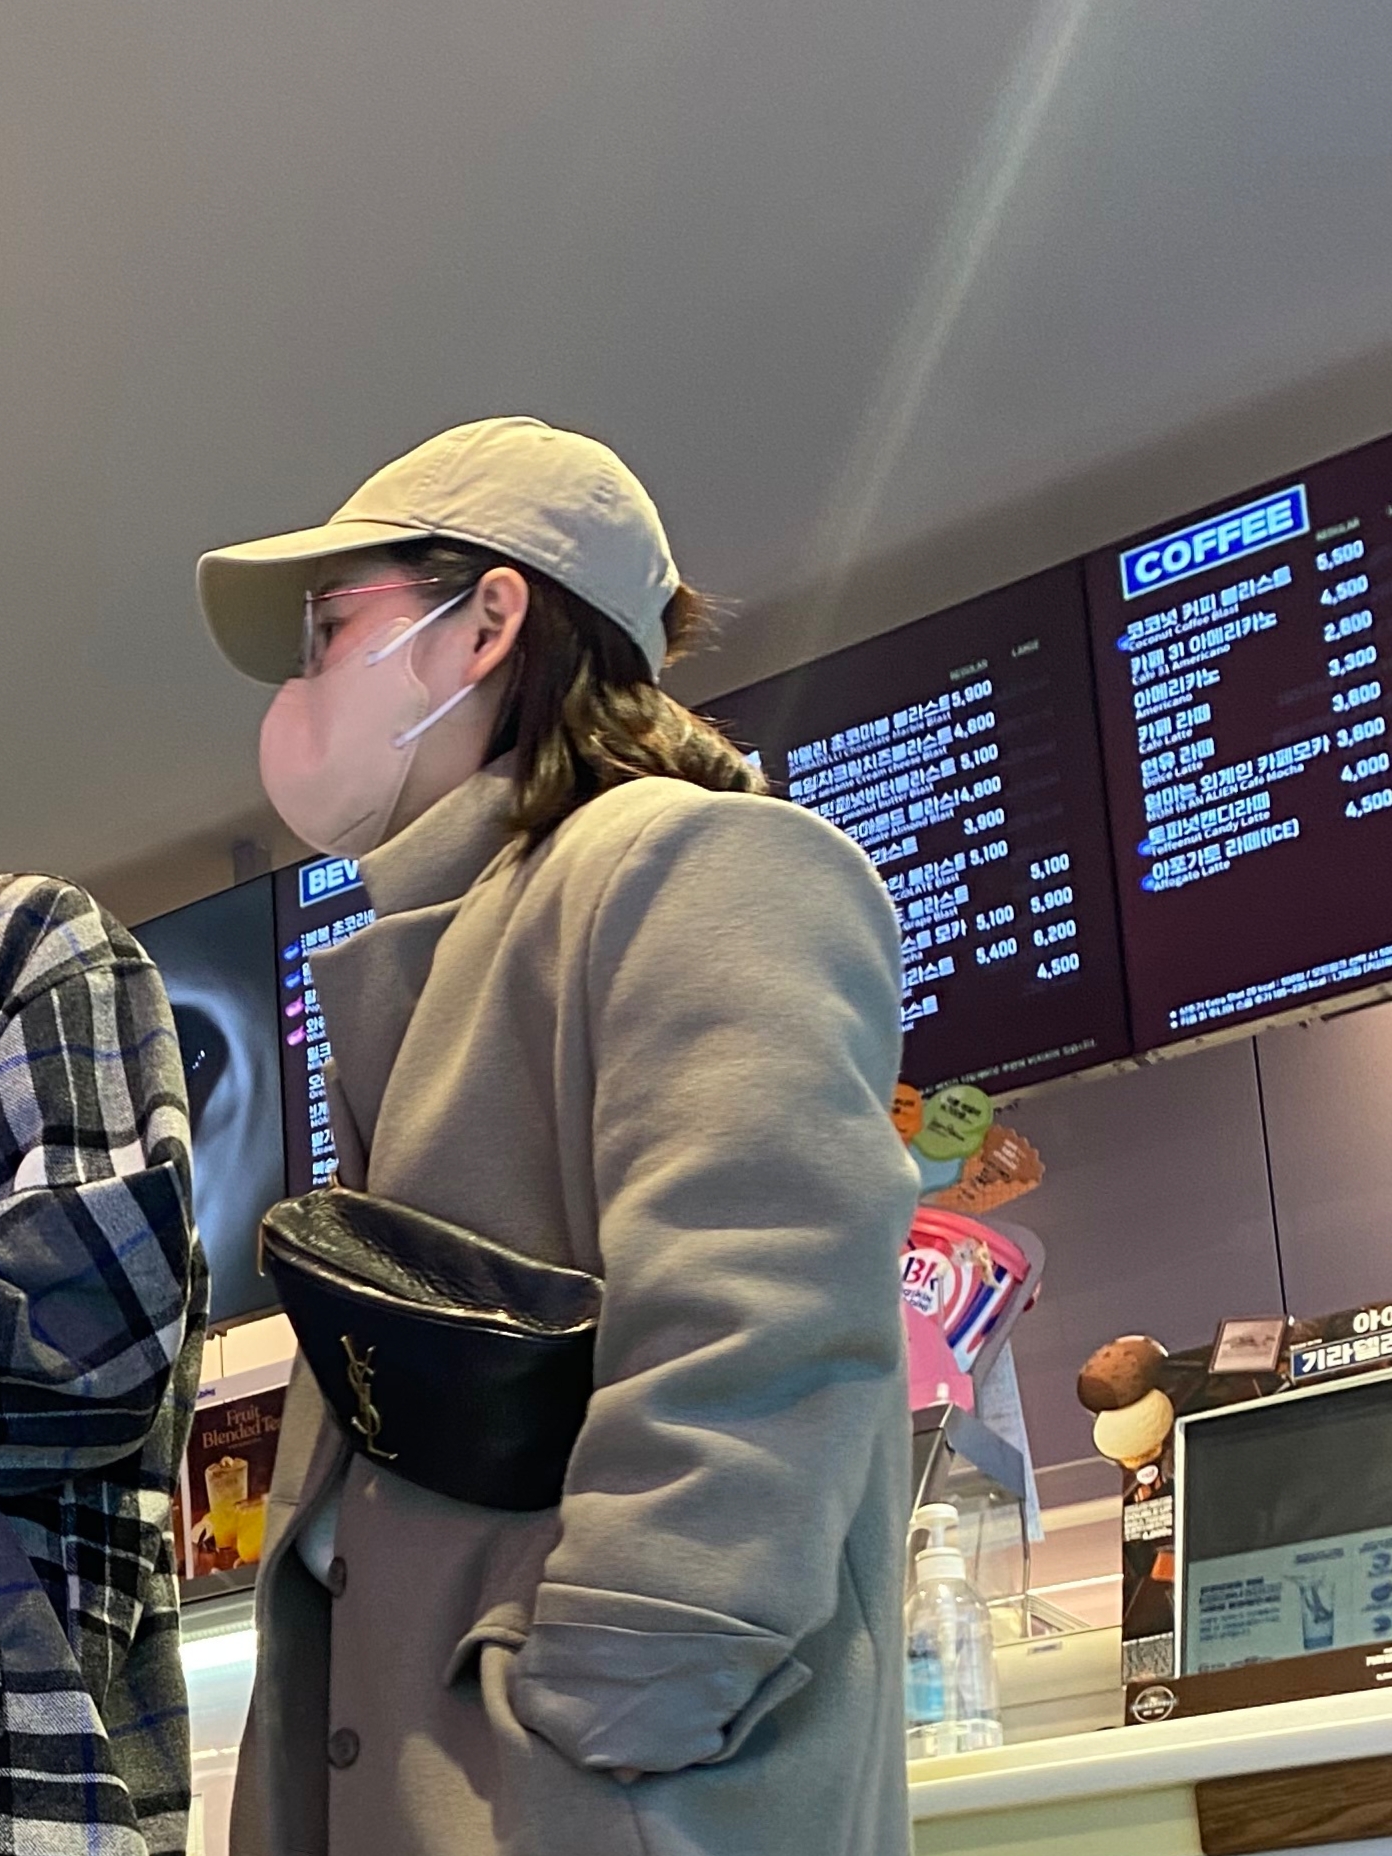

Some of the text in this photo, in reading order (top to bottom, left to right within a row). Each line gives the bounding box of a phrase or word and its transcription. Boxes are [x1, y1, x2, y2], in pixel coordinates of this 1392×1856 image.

[1135, 499, 1294, 583] COFFEE
[1168, 641, 1185, 659] 31
[1189, 612, 1279, 655] 아메리카노
[1320, 575, 1369, 605] 4,500
[1182, 594, 1217, 621] 커피
[1174, 615, 1210, 634] Coffee
[1172, 644, 1231, 670] Americano
[951, 680, 992, 708] 5,900
[1134, 669, 1221, 709] 아메리카노
[1138, 716, 1173, 743] 카페
[1328, 646, 1377, 678] 3,300
[1135, 692, 1194, 720] Americano
[960, 743, 999, 770] 5,100
[1200, 761, 1254, 793] 외계인
[1257, 734, 1331, 773] 카페모카
[1341, 752, 1390, 782] 4,000
[960, 776, 1001, 804] 4,800
[1205, 784, 1239, 805] ALIEN
[963, 808, 1005, 836] 3,900
[1204, 821, 1239, 841] Candy
[1240, 810, 1271, 829] Latte
[970, 840, 1008, 867] 5,100
[1030, 853, 1070, 880] 5,100
[1201, 860, 1231, 878] Latte
[935, 919, 968, 945] 모카
[975, 905, 1015, 931] 5,100
[1030, 886, 1073, 914] 5,900
[975, 937, 1018, 965] 5,400
[1037, 953, 1080, 980] 4,500
[227, 1405, 261, 1426] Fruit
[202, 1418, 262, 1449] Blended
